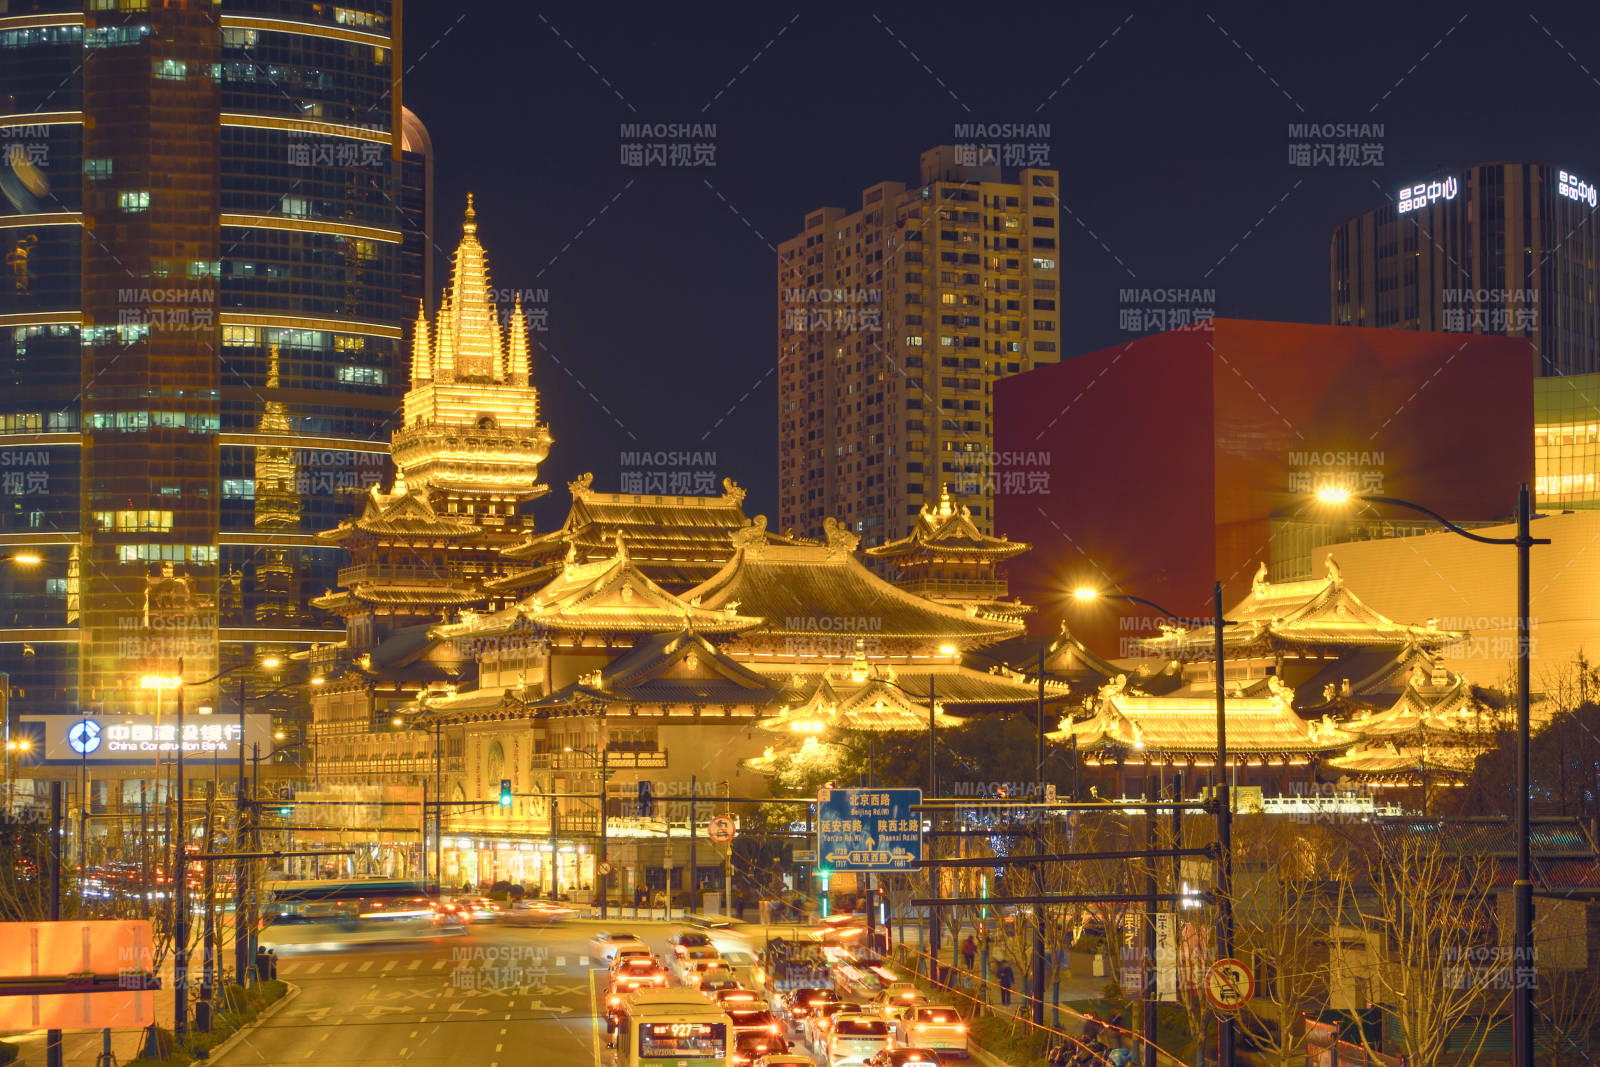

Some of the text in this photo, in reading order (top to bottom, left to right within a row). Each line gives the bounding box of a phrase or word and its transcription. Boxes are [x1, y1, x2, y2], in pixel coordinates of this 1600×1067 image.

[108, 741, 138, 751] China
[140, 741, 200, 751] Constrution
[850, 793, 890, 806] 北京西路
[821, 819, 862, 832] 延安西路
[878, 819, 918, 832] 陕西北路
[852, 853, 888, 861] 南京西路
[672, 1024, 693, 1036] 927
